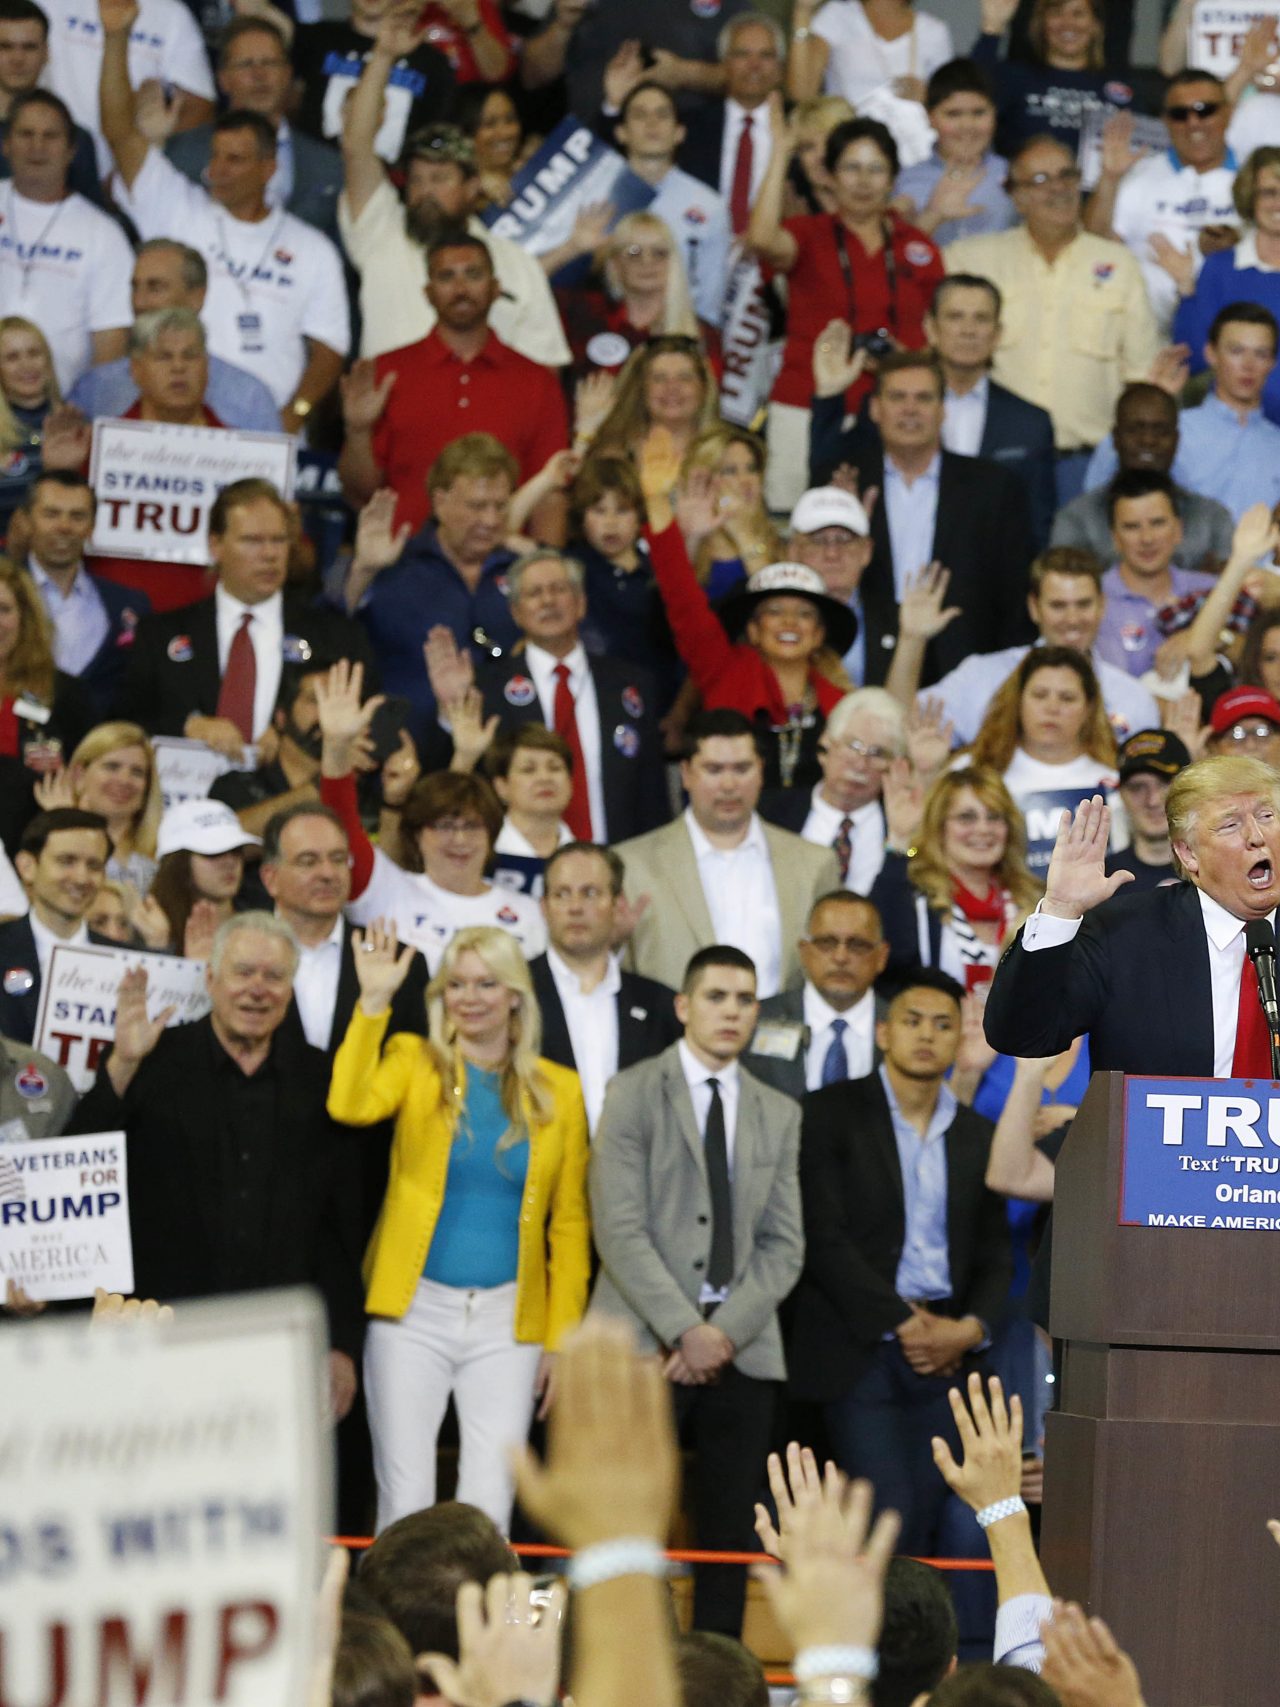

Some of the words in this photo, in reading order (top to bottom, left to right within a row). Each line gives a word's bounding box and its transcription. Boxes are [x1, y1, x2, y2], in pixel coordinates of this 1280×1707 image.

[490, 127, 594, 237] RUMP
[104, 471, 204, 494] STANDS
[13, 1148, 119, 1172] VETERANS
[1179, 1155, 1219, 1172] Text
[79, 1169, 119, 1186] FOR
[2, 1192, 121, 1225] RUMP
[1148, 1213, 1206, 1229] MAKE
